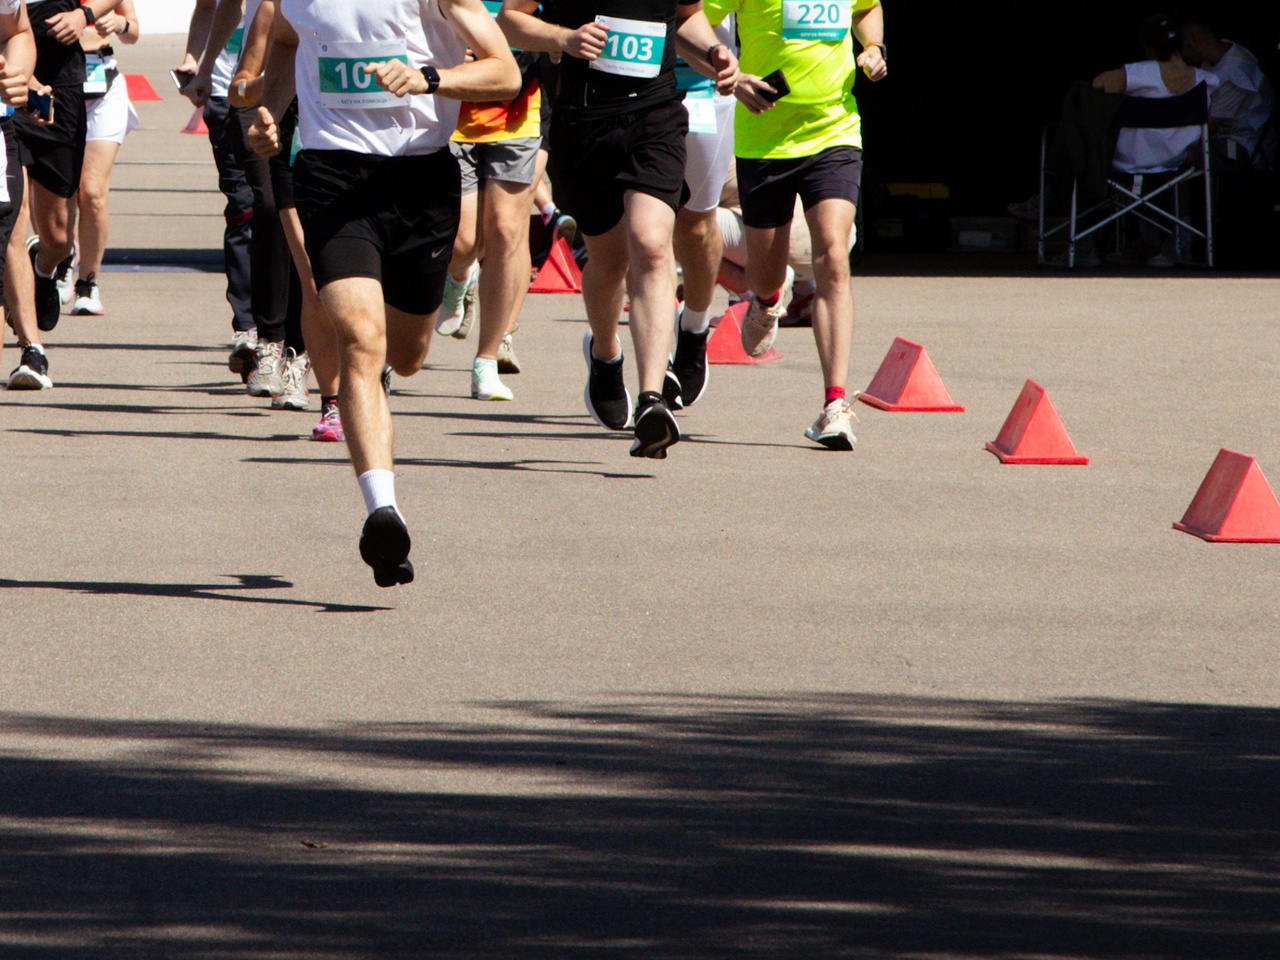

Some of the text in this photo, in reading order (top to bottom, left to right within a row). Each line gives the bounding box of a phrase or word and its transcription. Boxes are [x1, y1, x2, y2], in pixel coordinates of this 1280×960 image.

[797, 3, 840, 24] 220
[608, 34, 654, 61] 103
[334, 61, 386, 89] 10
